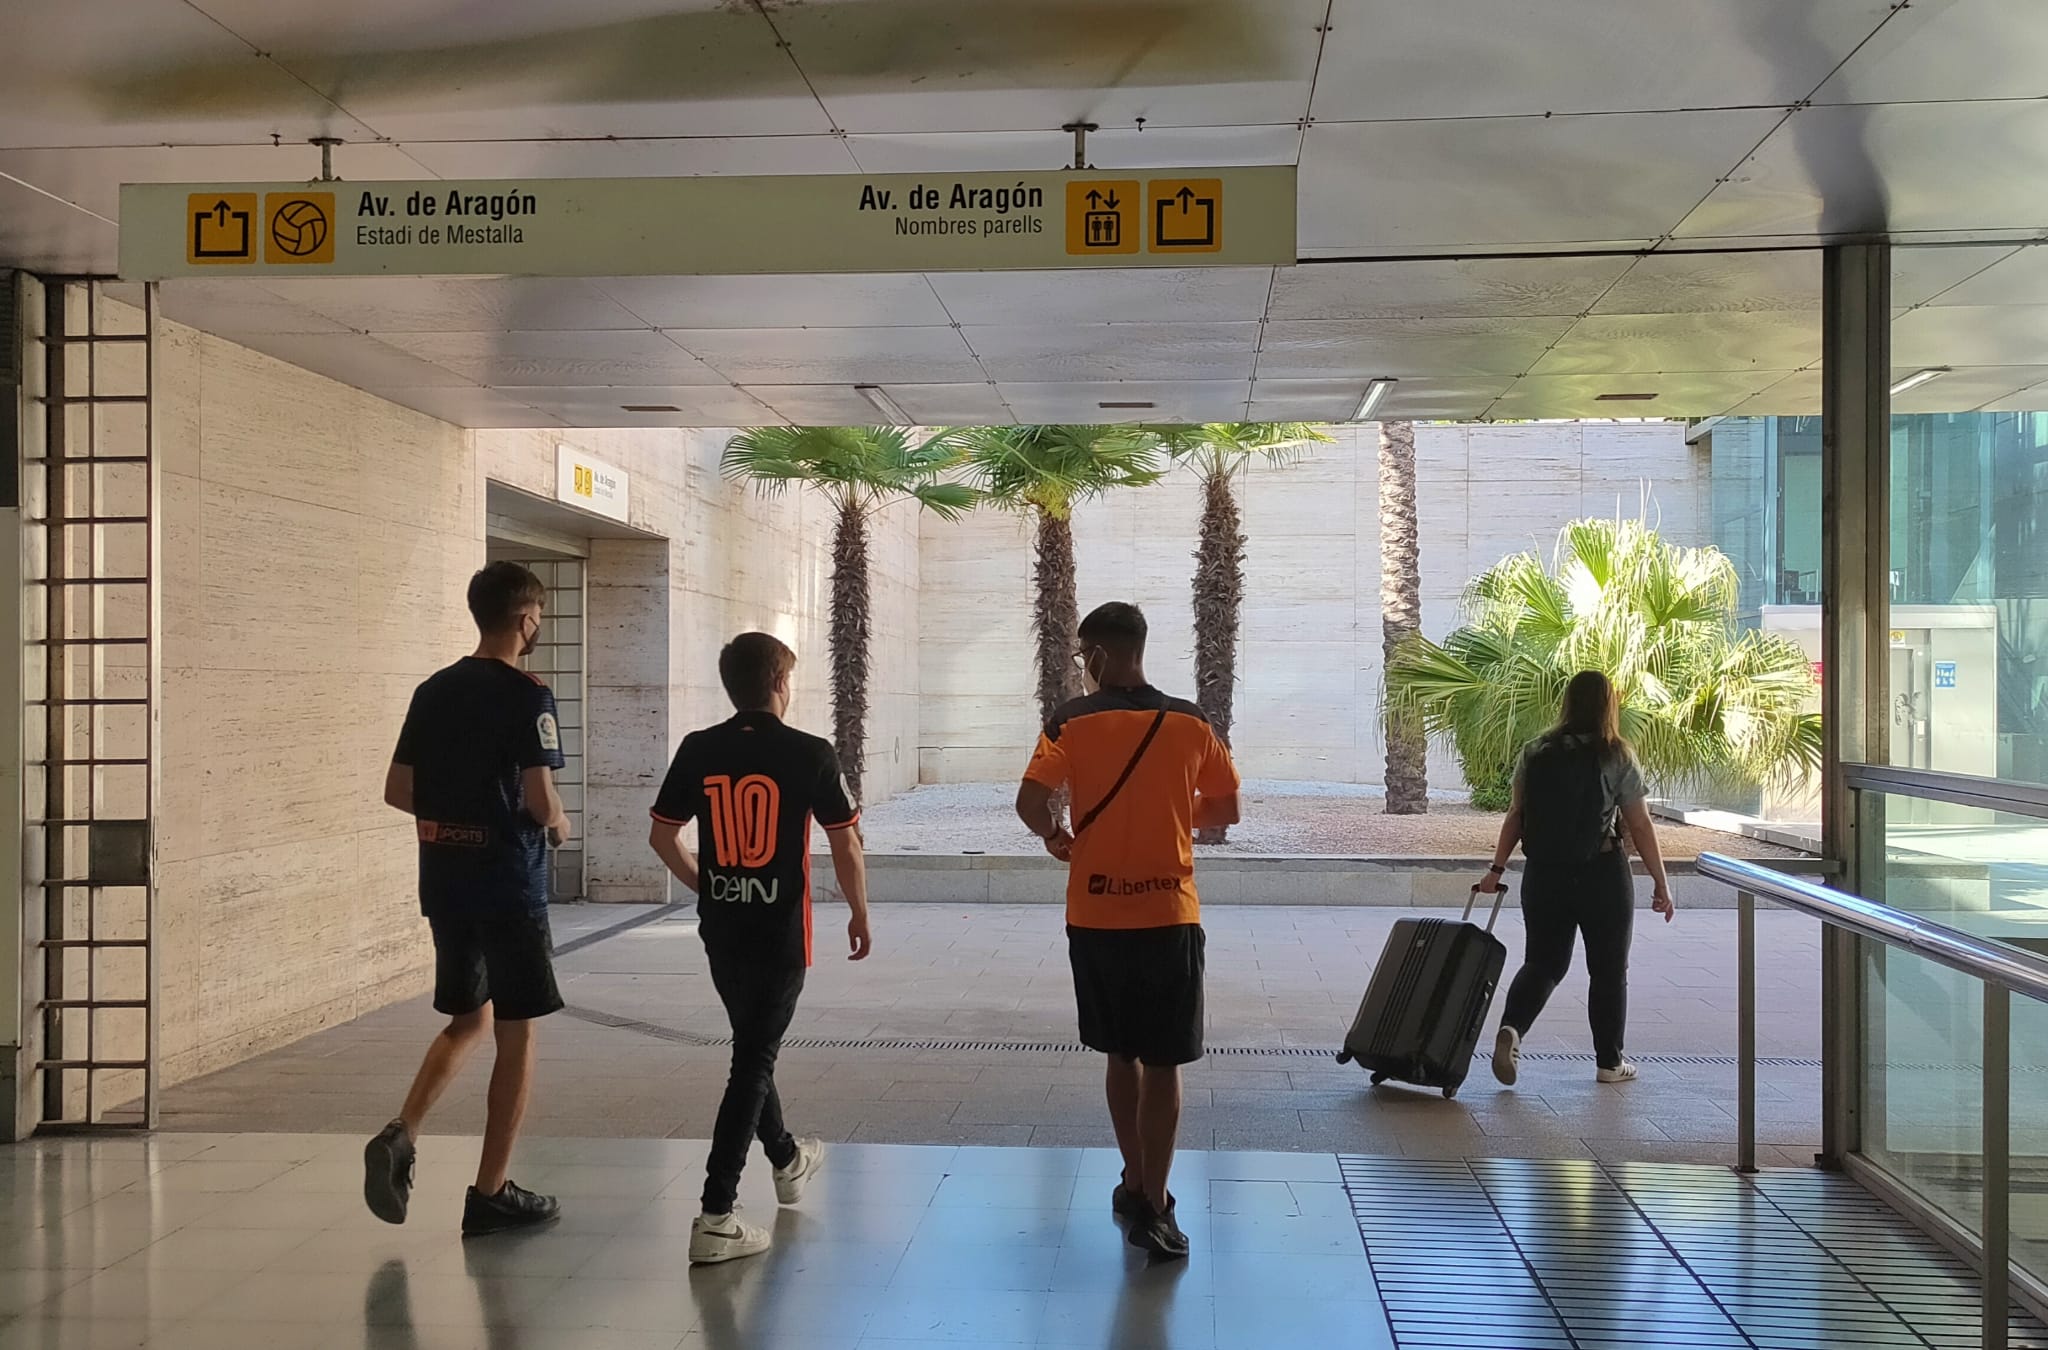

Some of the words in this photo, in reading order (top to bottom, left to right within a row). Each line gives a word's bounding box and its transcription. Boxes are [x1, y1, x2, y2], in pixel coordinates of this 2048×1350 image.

[357, 190, 395, 216] Av.
[406, 190, 436, 216] de
[445, 188, 536, 221] Aragón
[859, 184, 897, 210] Av.
[909, 183, 939, 210] de
[948, 181, 1042, 214] Aragón
[356, 224, 412, 245] Estadi
[418, 225, 440, 245] de
[447, 224, 524, 244] Mestalla
[895, 215, 977, 235] Nombres
[983, 214, 1042, 238] parells
[703, 774, 780, 868] 10
[1106, 876, 1182, 896] Libertex
